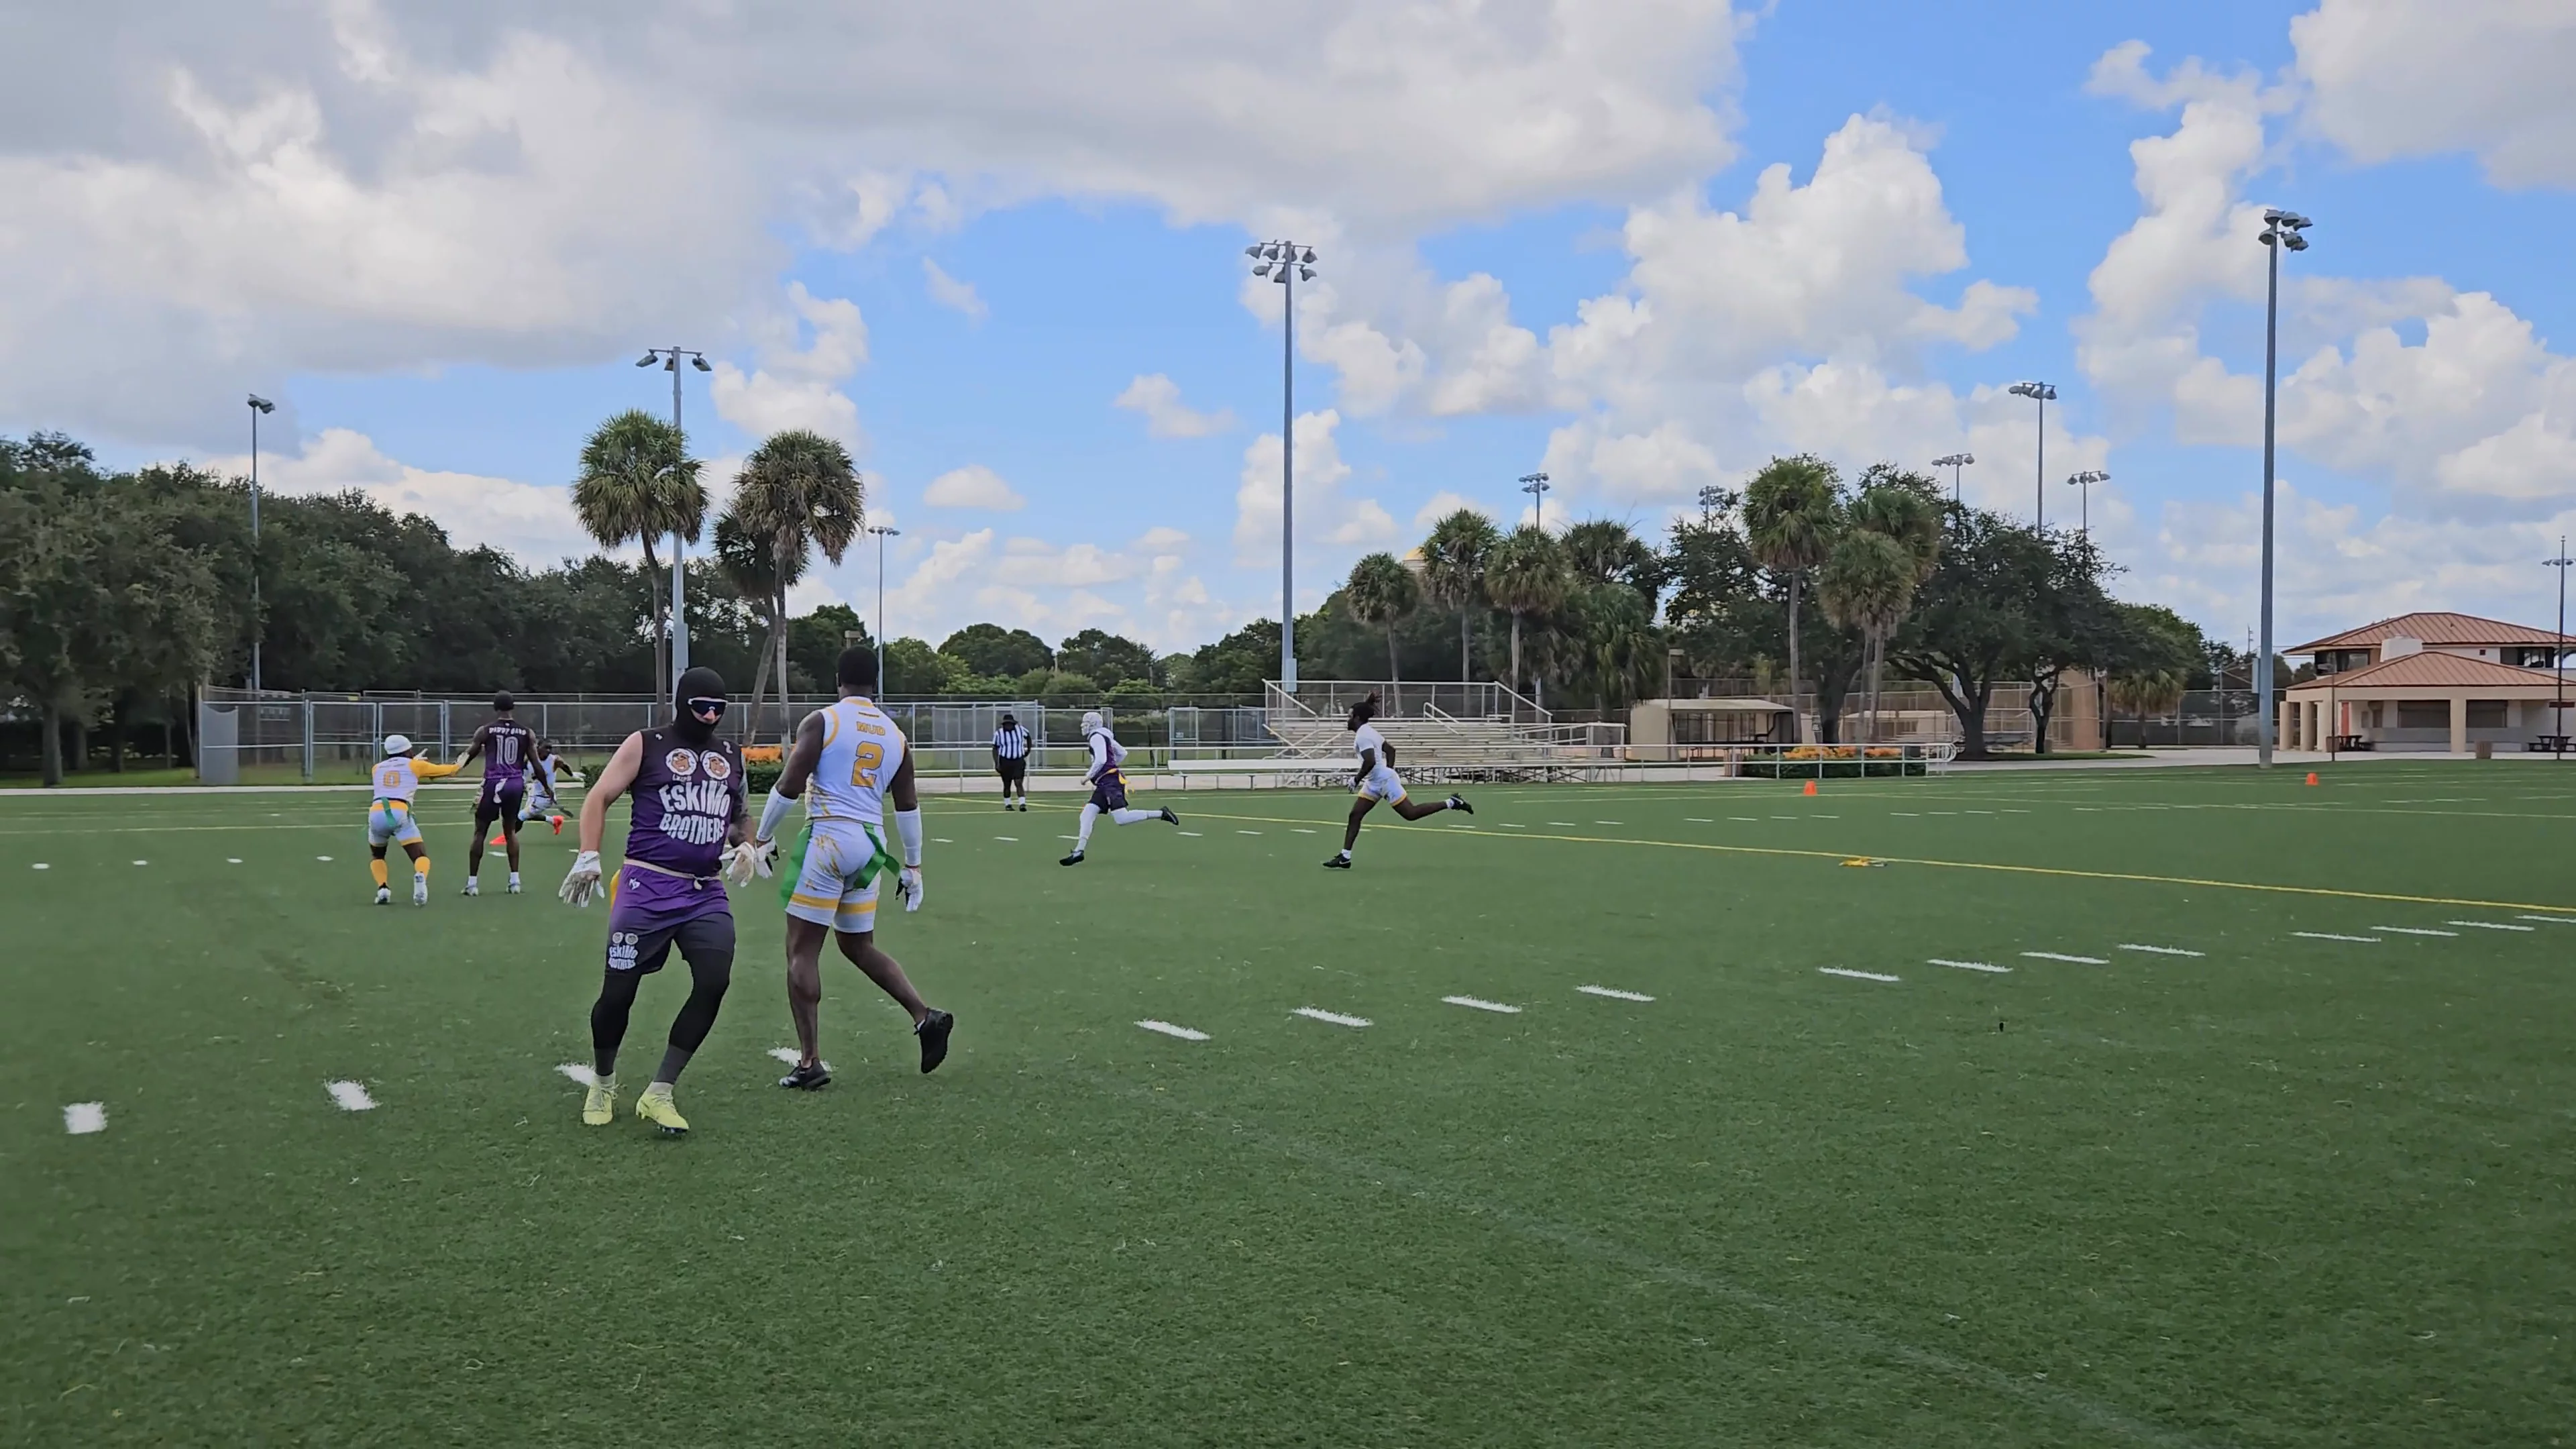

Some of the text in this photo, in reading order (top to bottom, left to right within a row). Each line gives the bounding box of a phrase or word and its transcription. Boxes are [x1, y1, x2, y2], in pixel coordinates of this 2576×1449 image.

[856, 721, 885, 736] MUD
[496, 735, 519, 765] 10
[851, 741, 885, 790] 2
[659, 780, 731, 817] ESKIMO
[659, 813, 725, 845] BROTHERS
